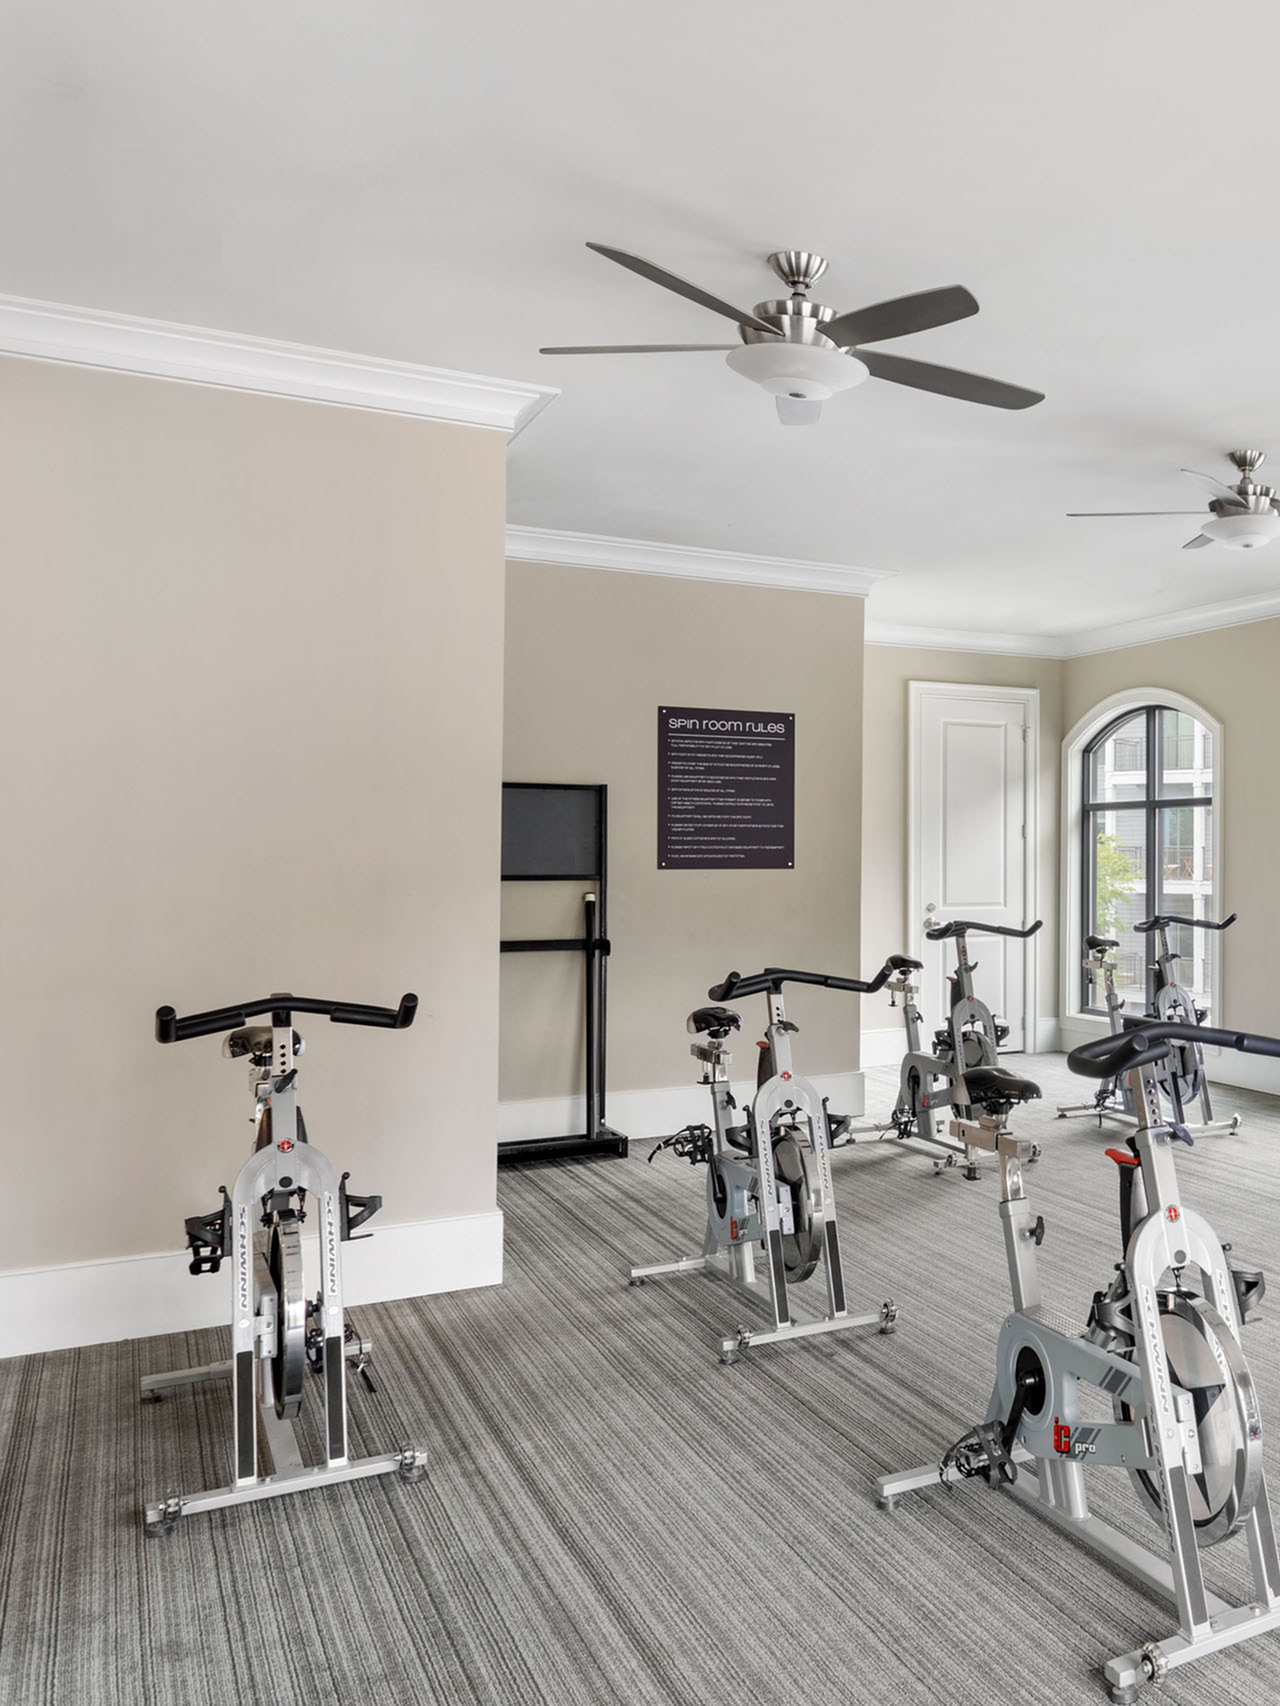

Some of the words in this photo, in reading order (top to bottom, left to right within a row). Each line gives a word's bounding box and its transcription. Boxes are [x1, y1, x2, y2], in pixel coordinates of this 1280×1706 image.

[702, 719, 743, 731] room
[239, 1205, 249, 1309] SCHWINN
[327, 1194, 337, 1294] SCHWINN
[1144, 1287, 1169, 1413] SCHWINN
[1075, 1442, 1097, 1455] pro
